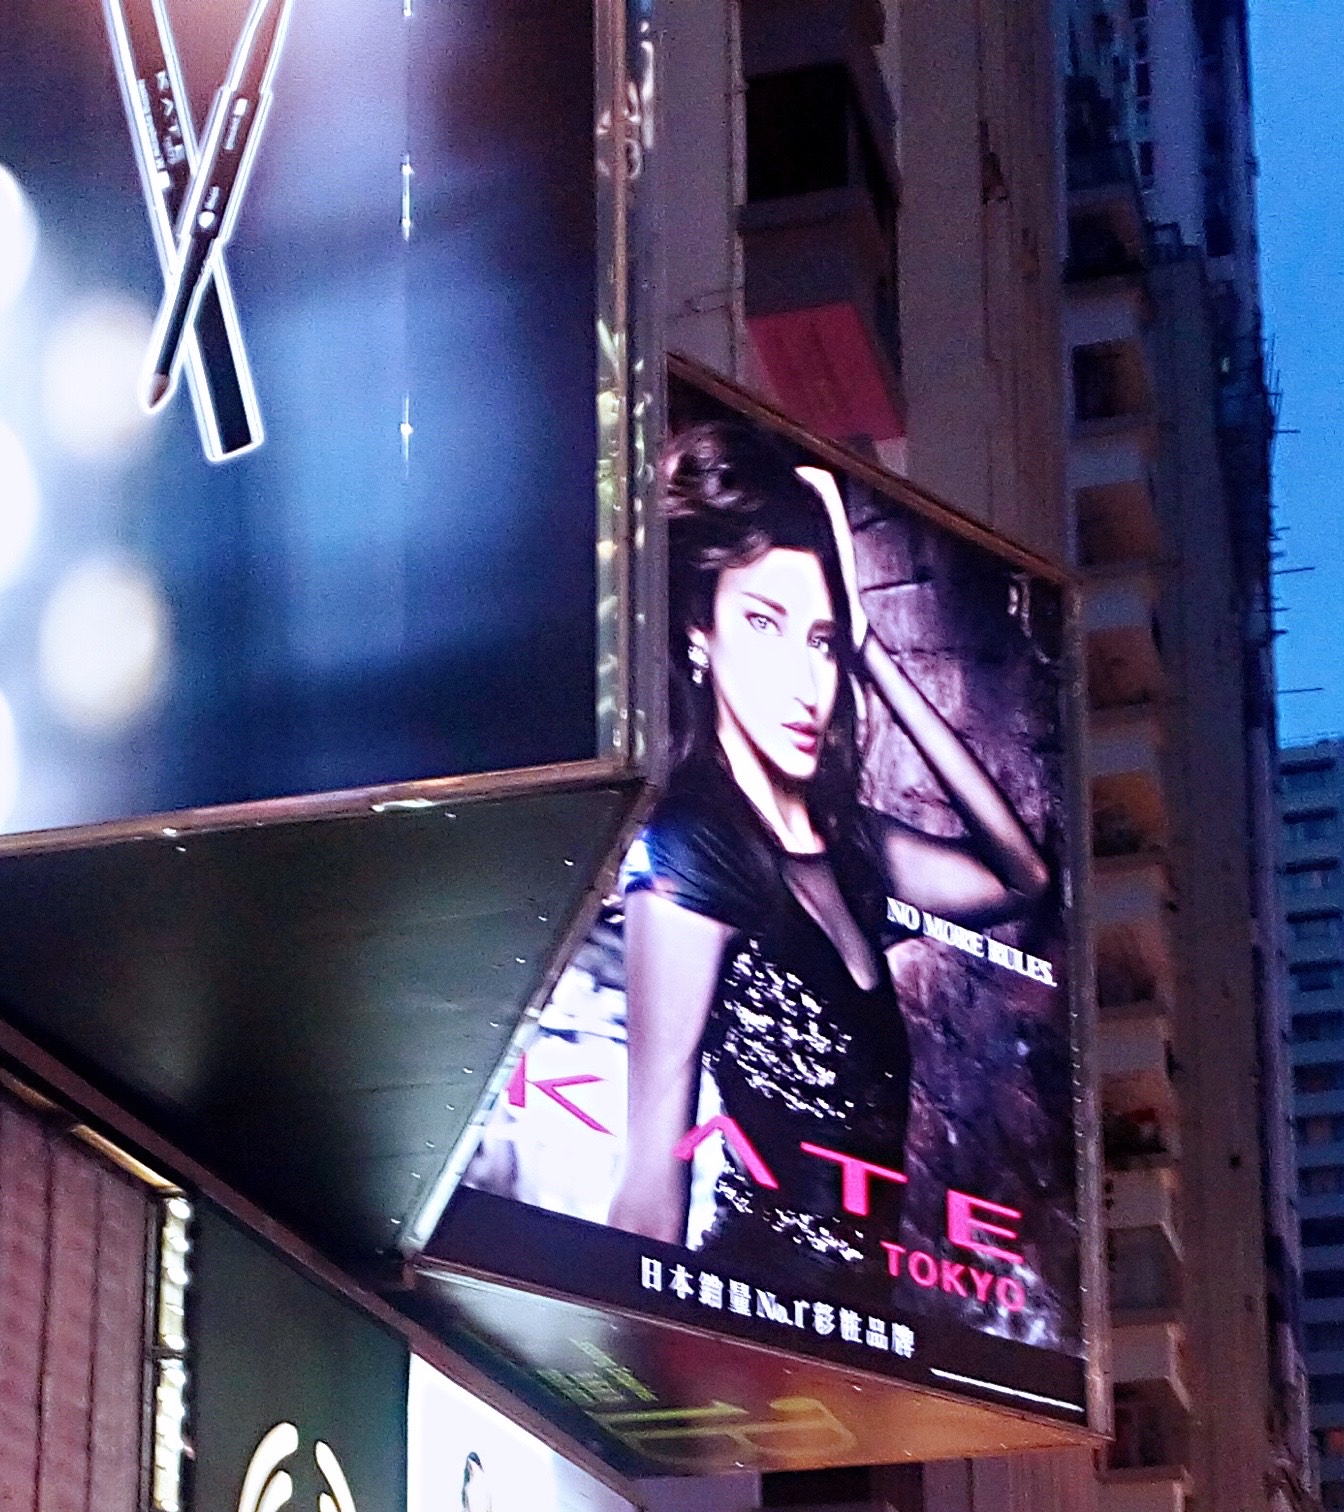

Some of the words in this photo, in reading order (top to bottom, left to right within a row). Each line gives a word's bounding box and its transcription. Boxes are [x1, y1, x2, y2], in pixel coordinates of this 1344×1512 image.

[886, 896, 921, 931] NO
[922, 911, 985, 958] MORE
[880, 1239, 1027, 1313] TOKYO
